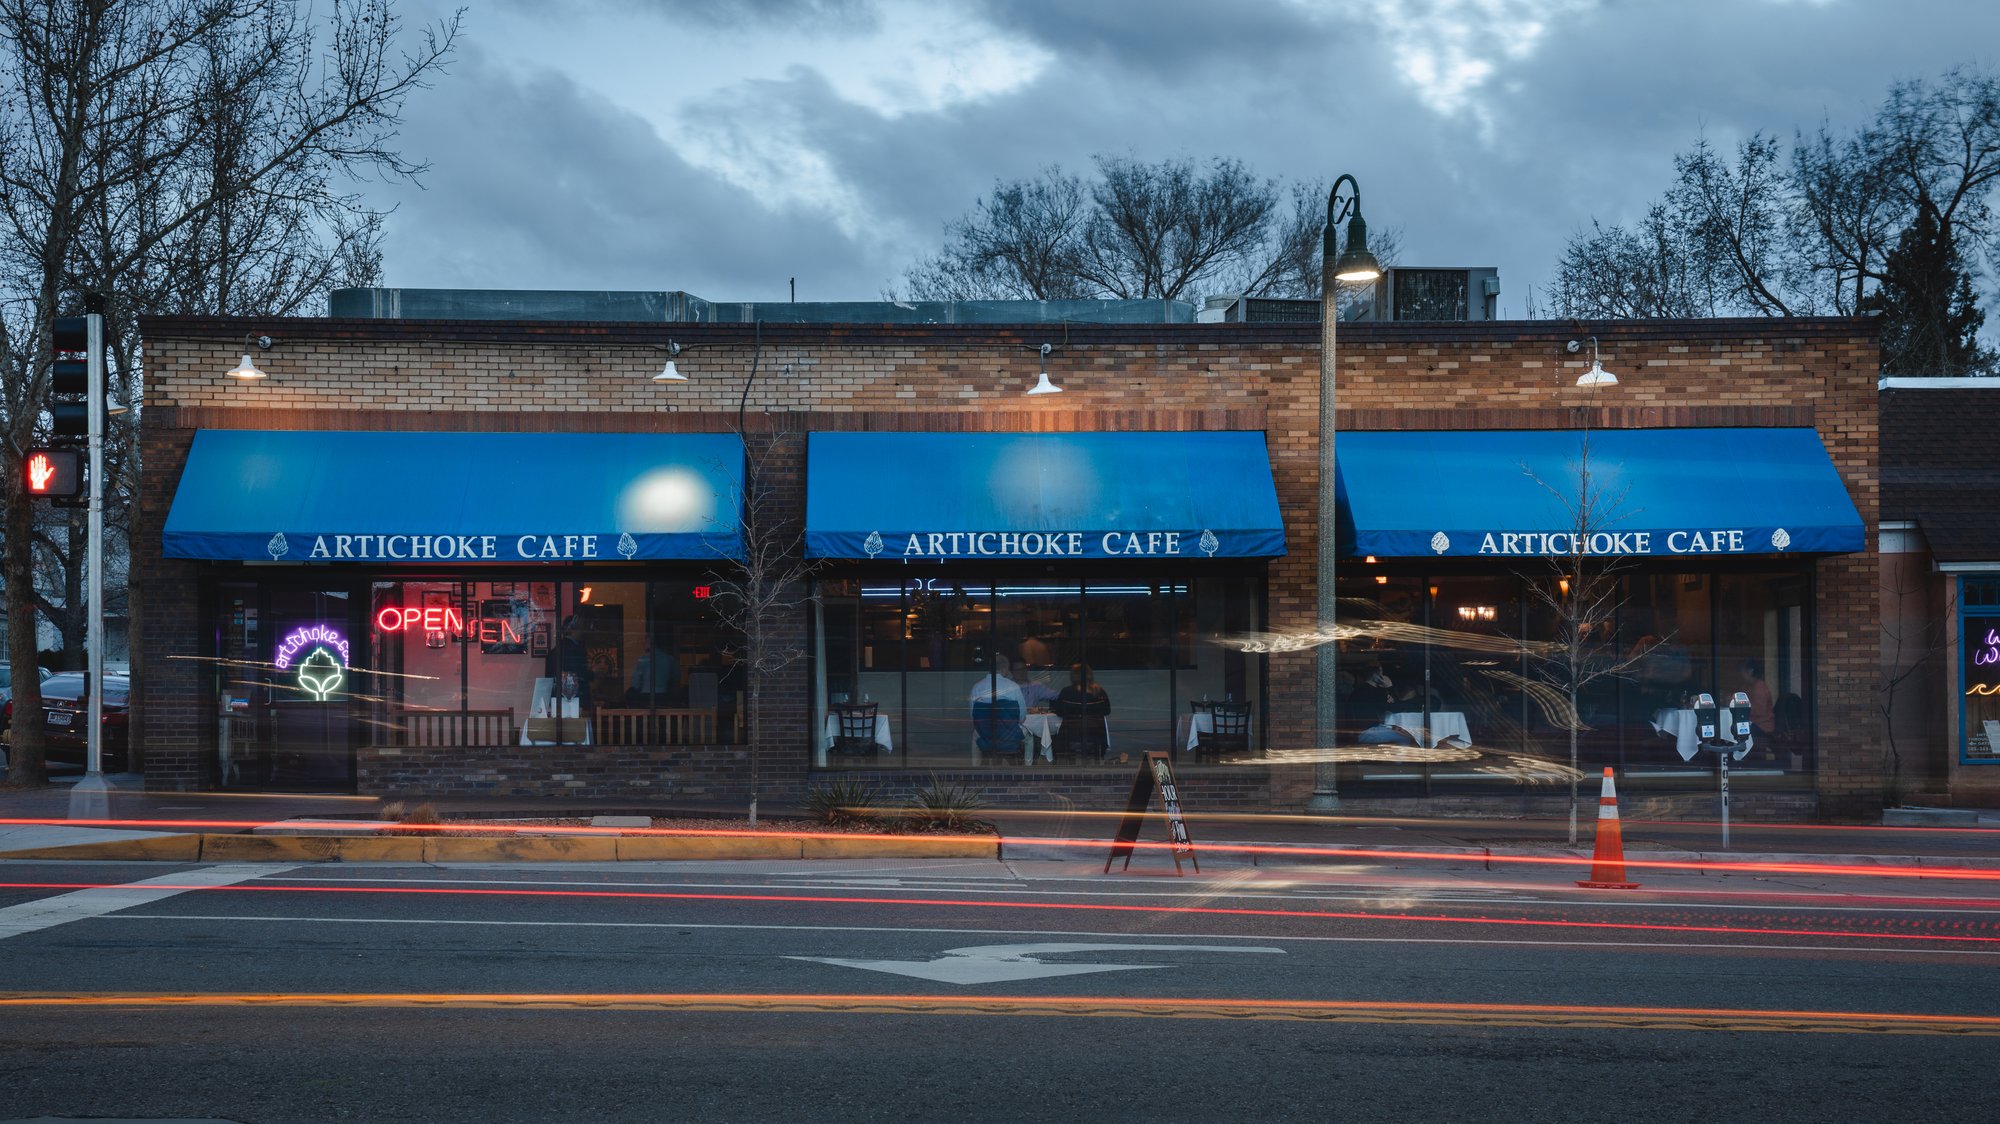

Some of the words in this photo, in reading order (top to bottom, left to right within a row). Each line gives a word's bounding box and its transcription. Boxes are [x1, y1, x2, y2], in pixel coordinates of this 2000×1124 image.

[309, 534, 497, 559] ARTICHOKE
[517, 535, 598, 558] CAFE
[904, 532, 1083, 556] ARTICHOKE
[1102, 532, 1180, 555] CAFE
[1478, 532, 1651, 554] ARTICHOKE
[1667, 530, 1744, 552] CAFE
[695, 586, 710, 598] EXIT
[379, 608, 463, 631] OPEN
